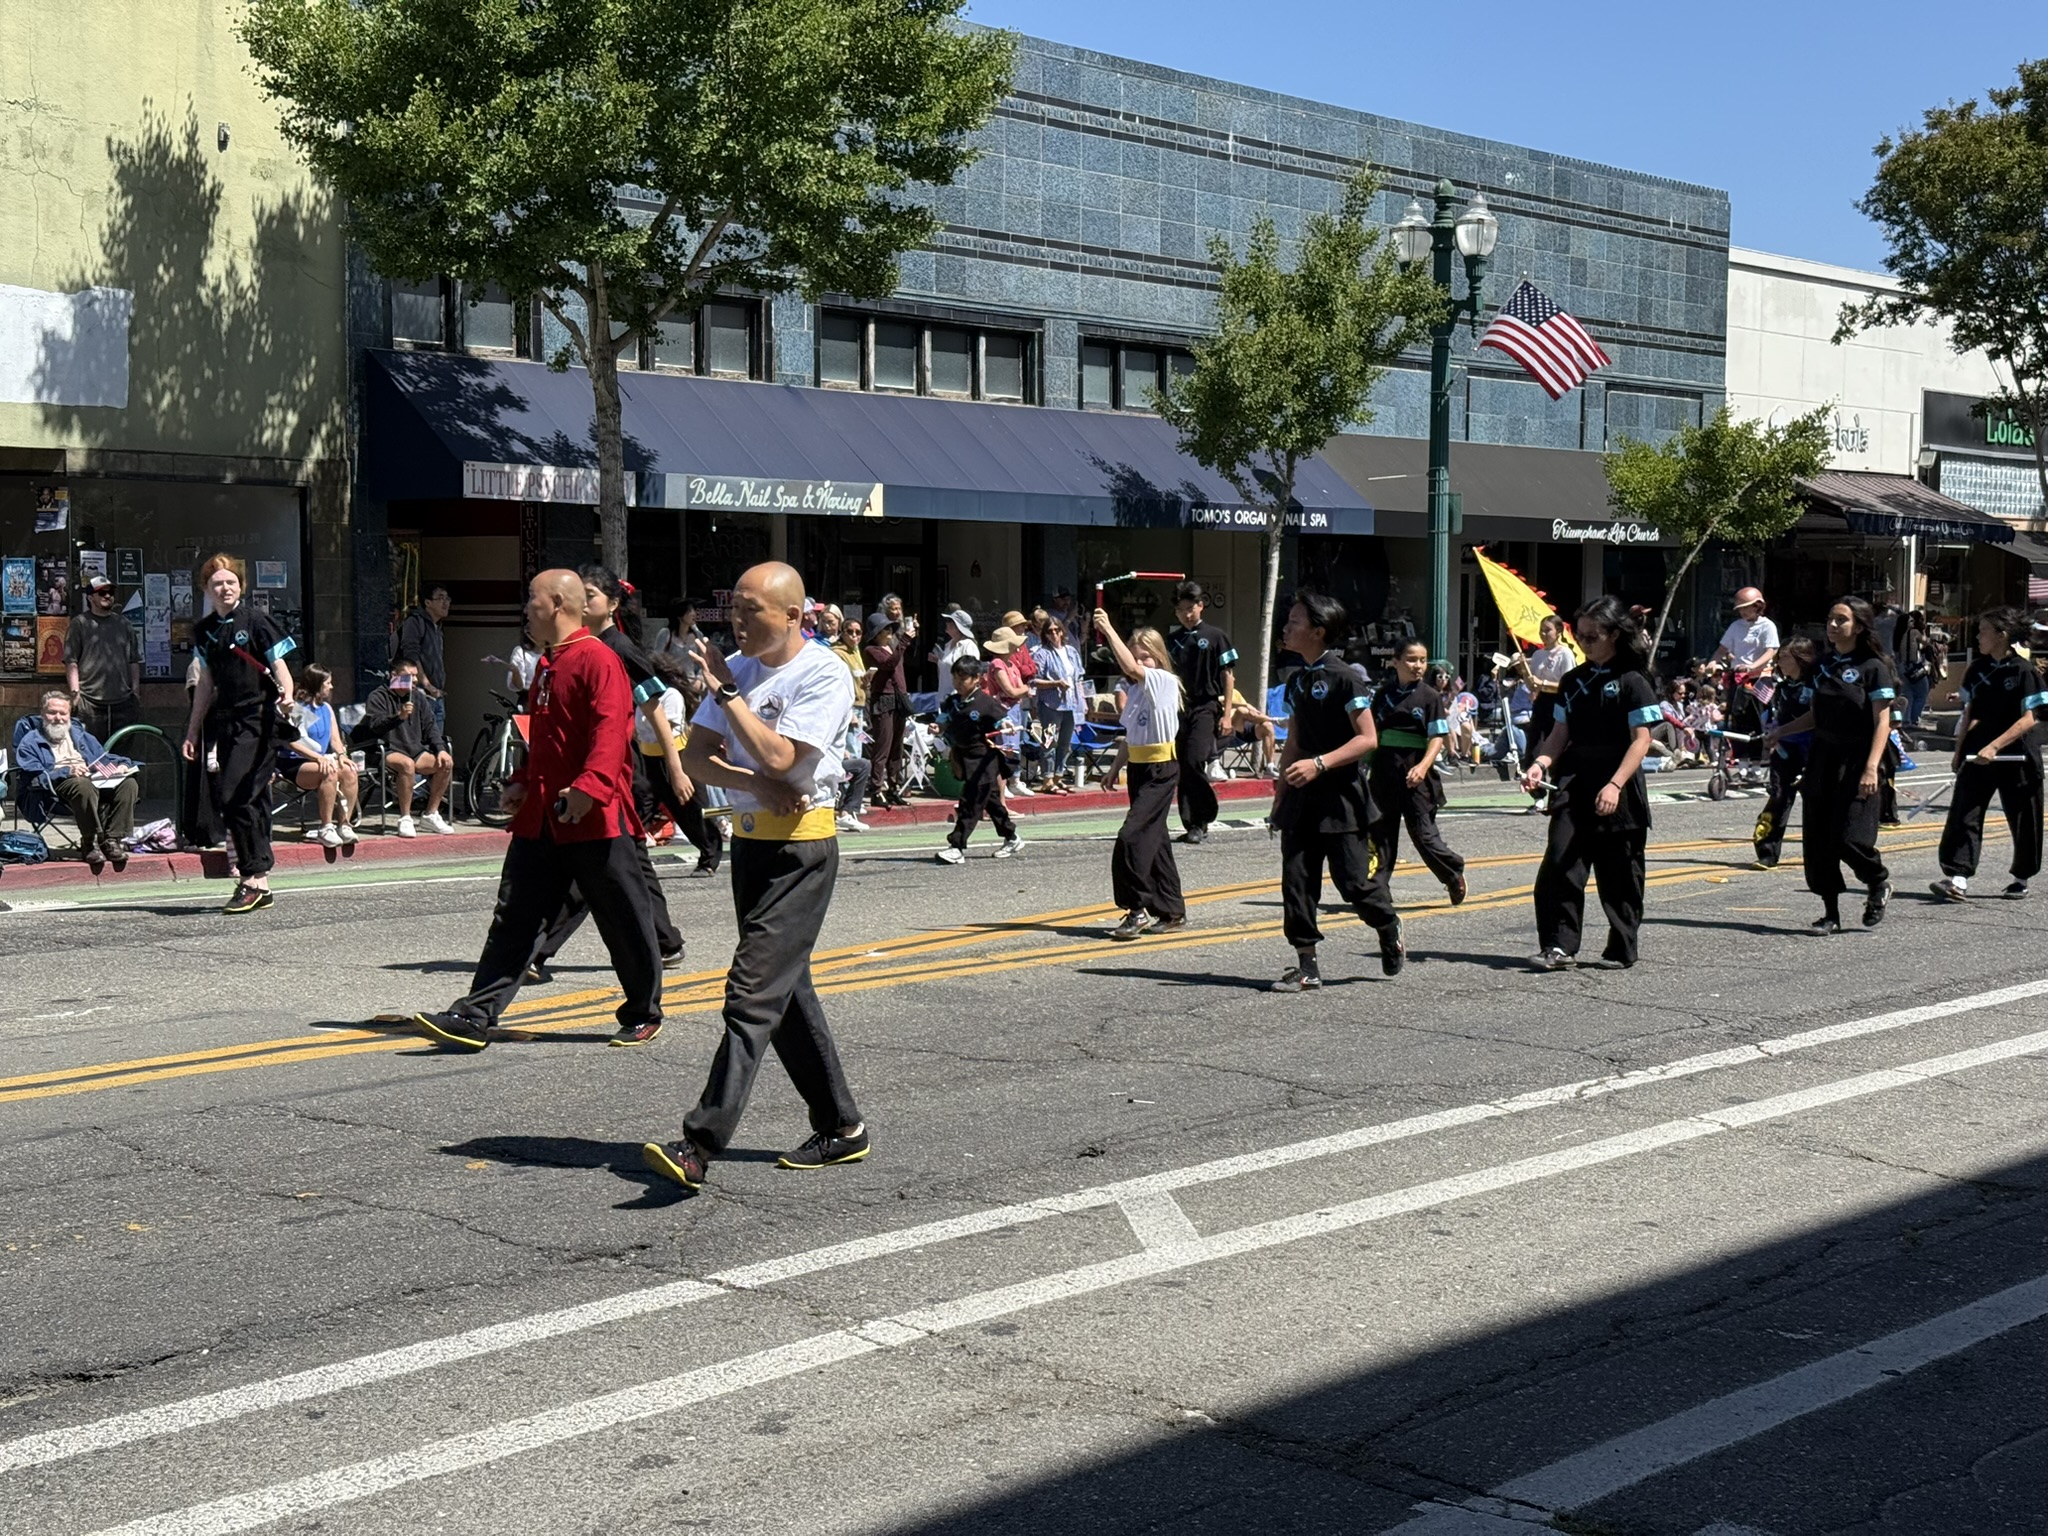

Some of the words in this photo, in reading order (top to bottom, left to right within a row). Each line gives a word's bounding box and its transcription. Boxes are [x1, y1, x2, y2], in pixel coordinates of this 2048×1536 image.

[471, 468, 523, 498] LITTLE
[690, 477, 733, 506] Bella
[735, 479, 772, 507] Nail
[773, 485, 799, 512] Spa
[802, 484, 815, 508] &
[815, 485, 863, 515] Waxing
[1191, 508, 1231, 524] TOMO'S
[1309, 512, 1328, 527] SPA
[1552, 518, 1607, 543] Triumphant
[1607, 522, 1626, 545] Life
[1627, 523, 1660, 542] Church
